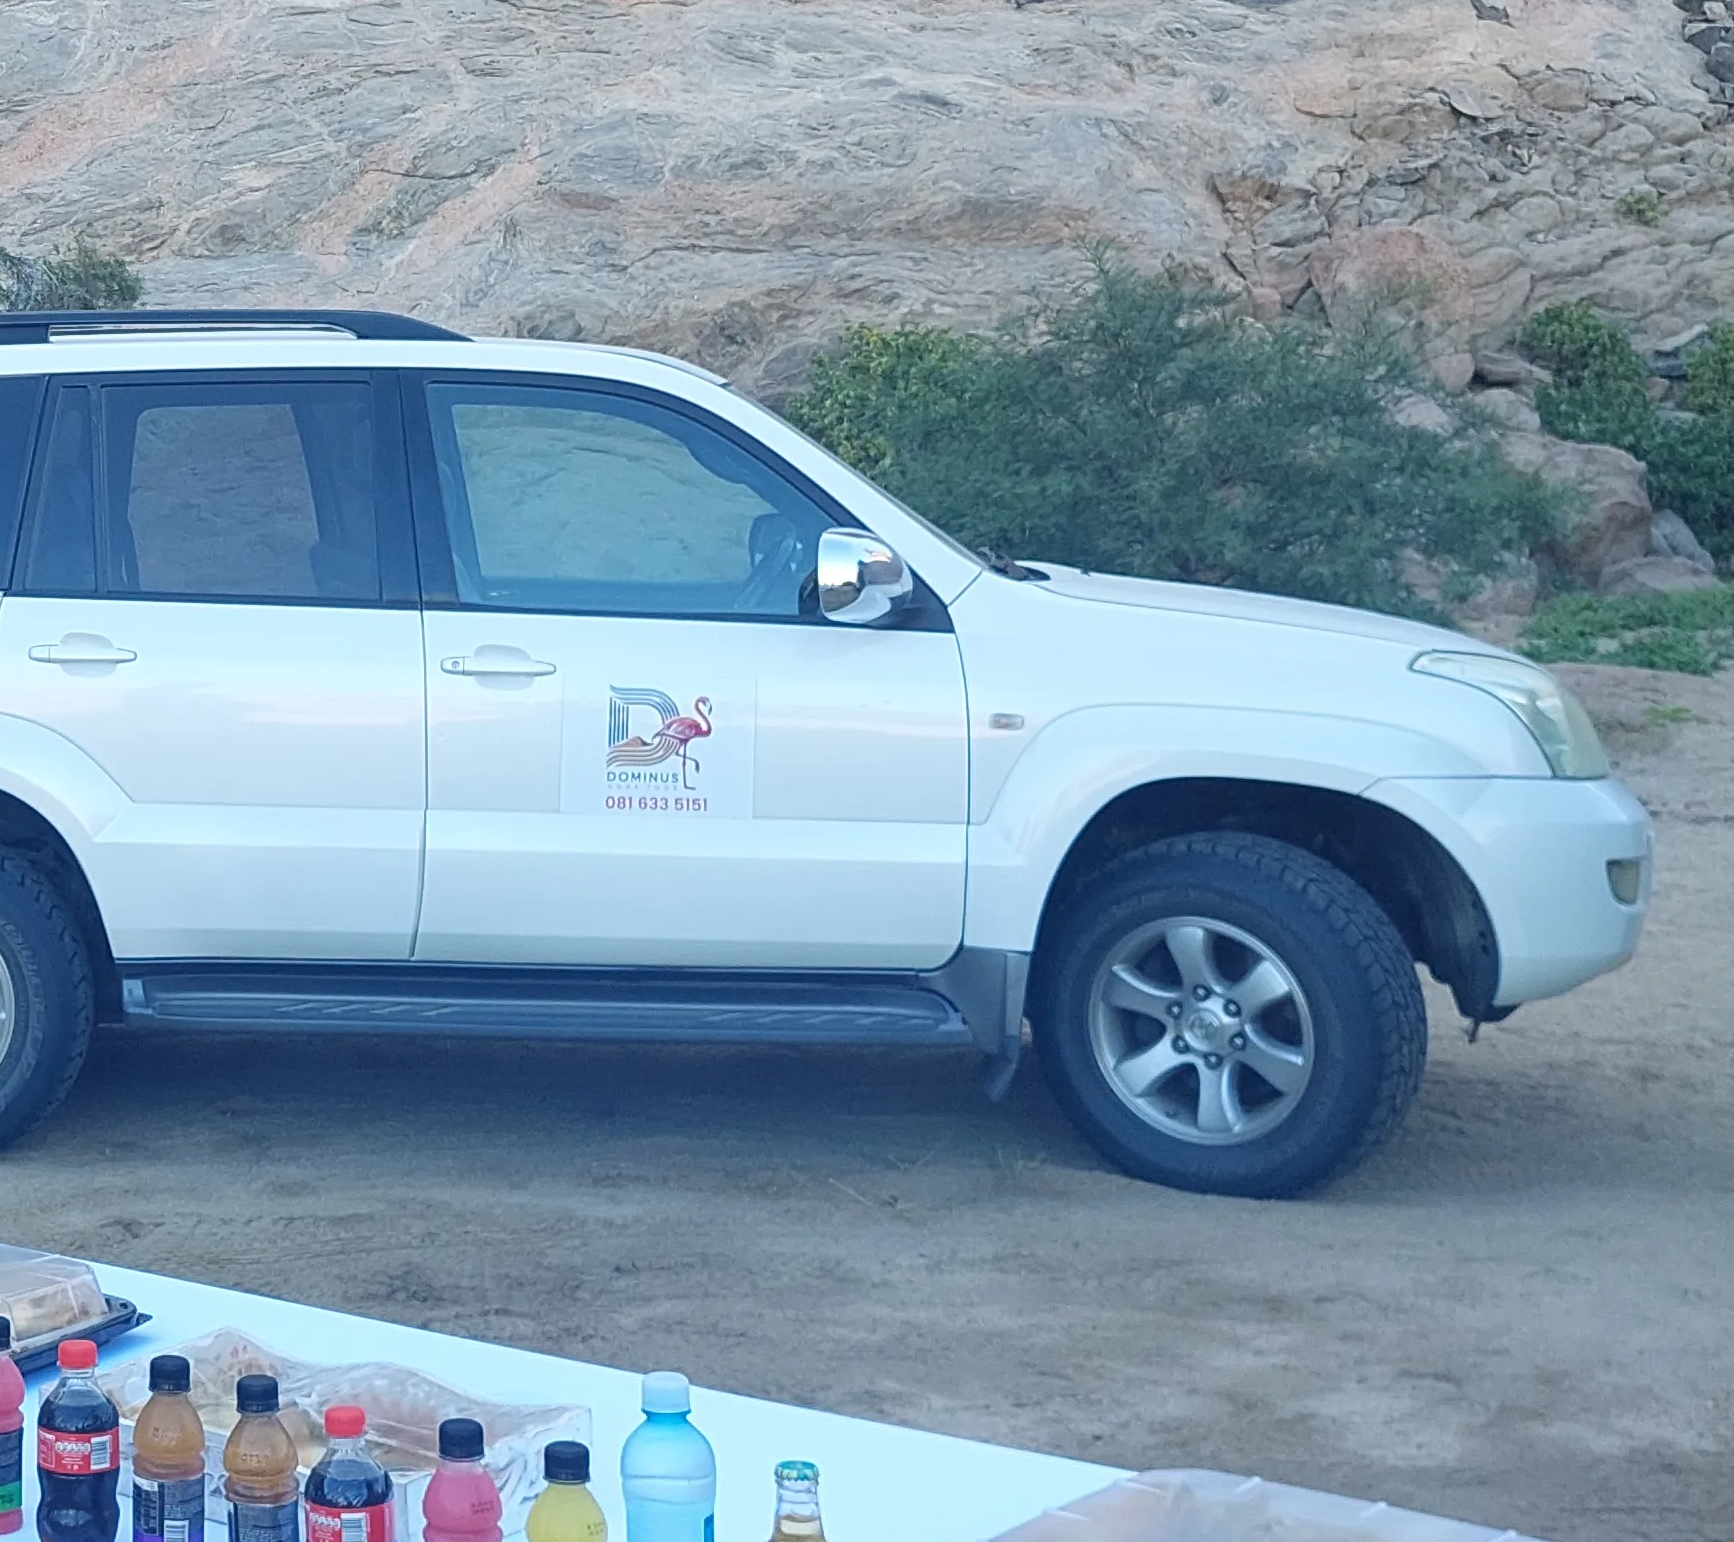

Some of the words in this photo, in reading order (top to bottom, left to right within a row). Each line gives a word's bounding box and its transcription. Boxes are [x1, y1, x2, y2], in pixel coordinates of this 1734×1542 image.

[606, 771, 679, 784] DOMINUS
[605, 795, 633, 810] 081
[638, 796, 669, 810] 633
[674, 797, 708, 811] 5151
